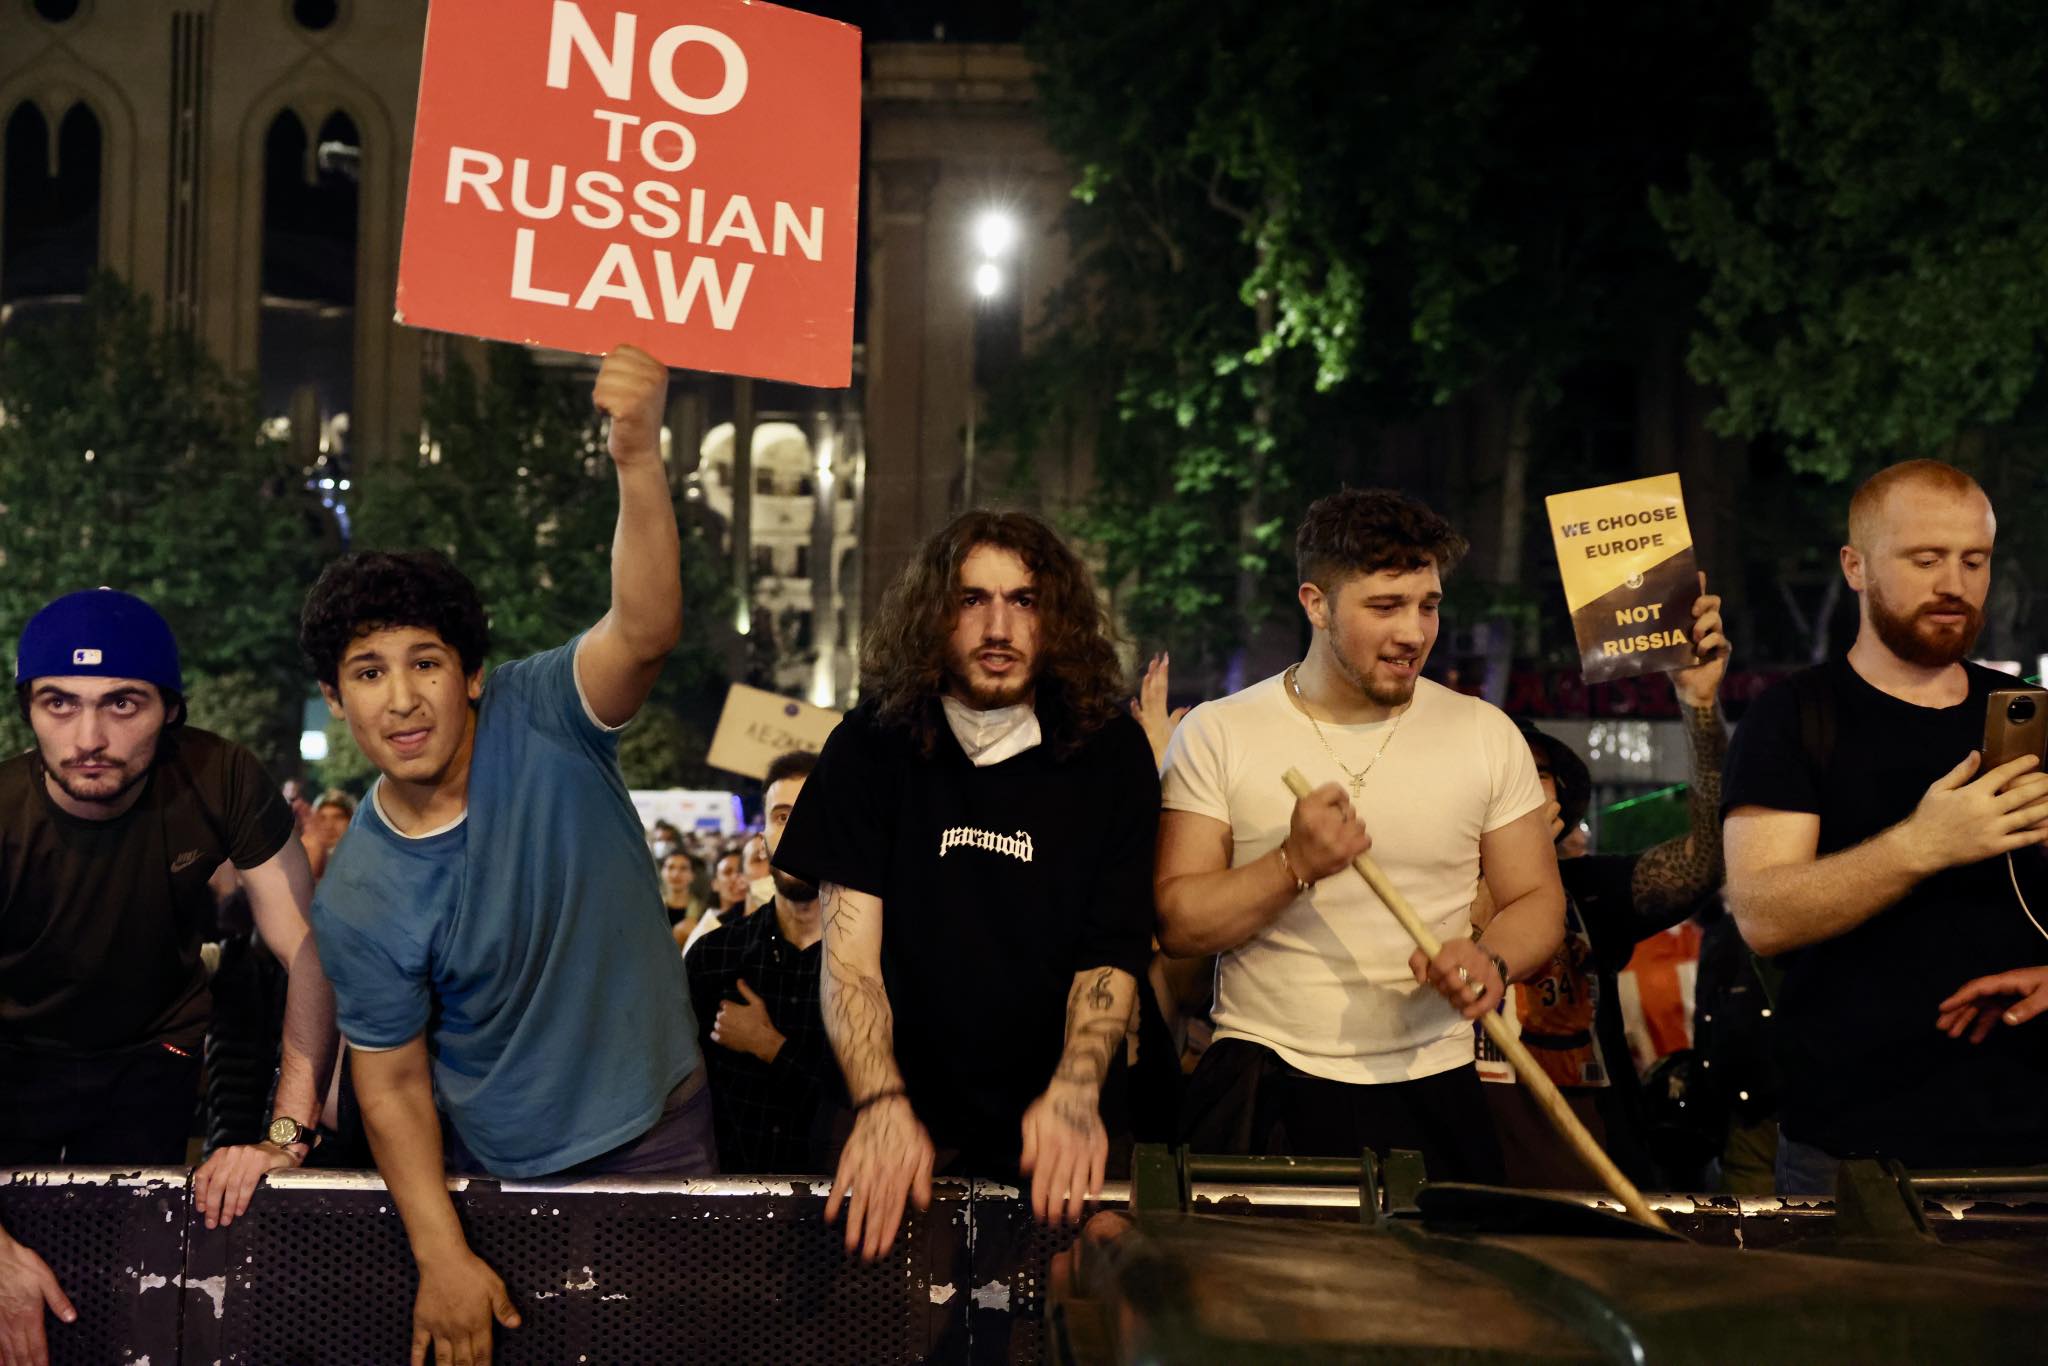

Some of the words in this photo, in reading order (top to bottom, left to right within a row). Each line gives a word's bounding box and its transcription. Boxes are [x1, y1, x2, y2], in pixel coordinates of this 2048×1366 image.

[547, 0, 749, 115] NO
[593, 109, 697, 172] TO
[444, 146, 825, 261] RUSSIAN
[510, 228, 755, 331] LAW
[1562, 522, 1591, 538] WE
[1597, 507, 1677, 531] CHOOSE
[1585, 534, 1664, 558] EUROPE
[1615, 603, 1663, 626] NOT
[1603, 629, 1687, 657] RUSSIA
[939, 826, 1034, 862] paranoid
[1537, 973, 1575, 1006] 34
